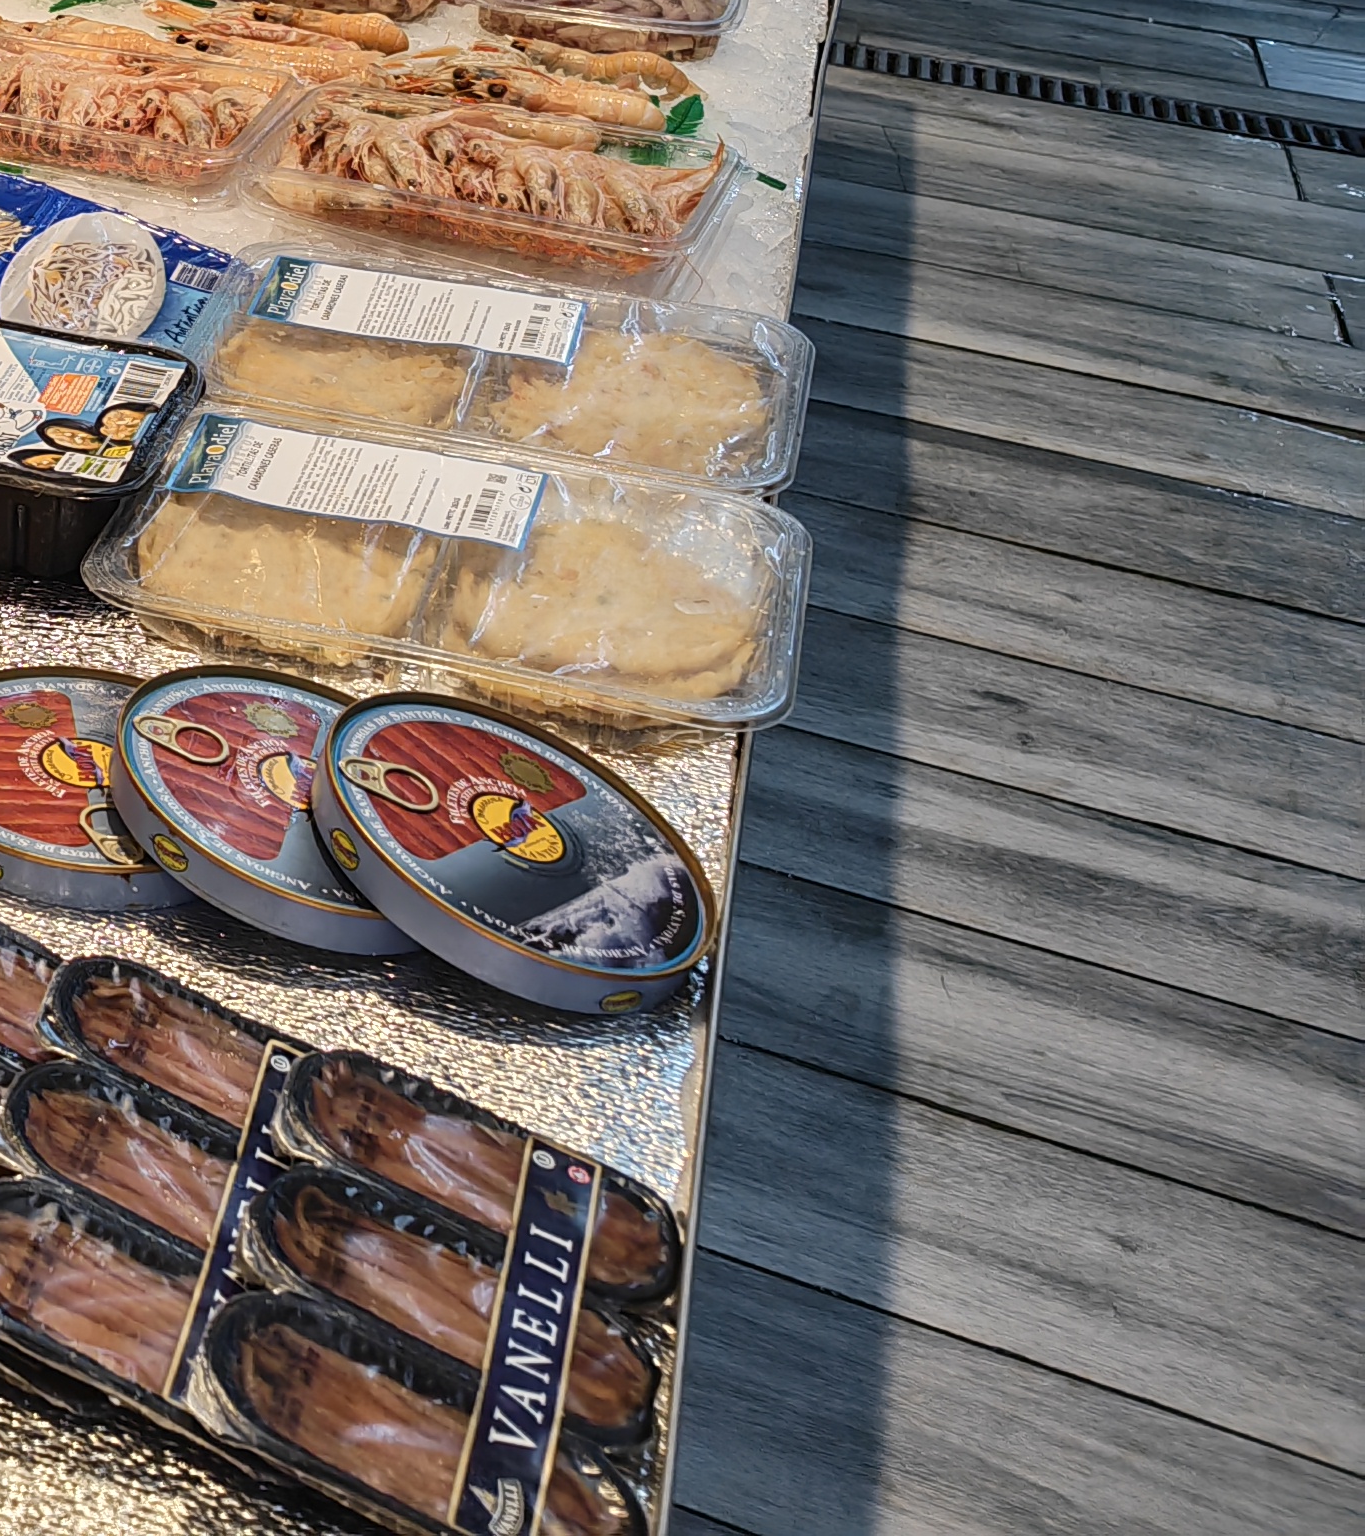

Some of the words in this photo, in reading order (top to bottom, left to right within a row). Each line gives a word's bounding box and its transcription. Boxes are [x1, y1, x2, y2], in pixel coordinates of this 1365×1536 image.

[187, 422, 240, 487] PlayaOdiel
[246, 457, 272, 492] CAMARONES
[264, 436, 283, 462] CASERAS
[13, 683, 32, 694] DE
[18, 729, 56, 754] ANCHOA
[345, 723, 373, 756] ANCHOAS
[373, 714, 391, 727] DE
[391, 709, 454, 723] SANTOÑA
[470, 718, 541, 753] ANCHOAS
[544, 750, 566, 766] DE
[446, 783, 466, 825] FILETES
[469, 773, 528, 799] ANCHOA
[518, 833, 561, 860] SANTOÑA
[487, 1221, 577, 1453] VANELLI
